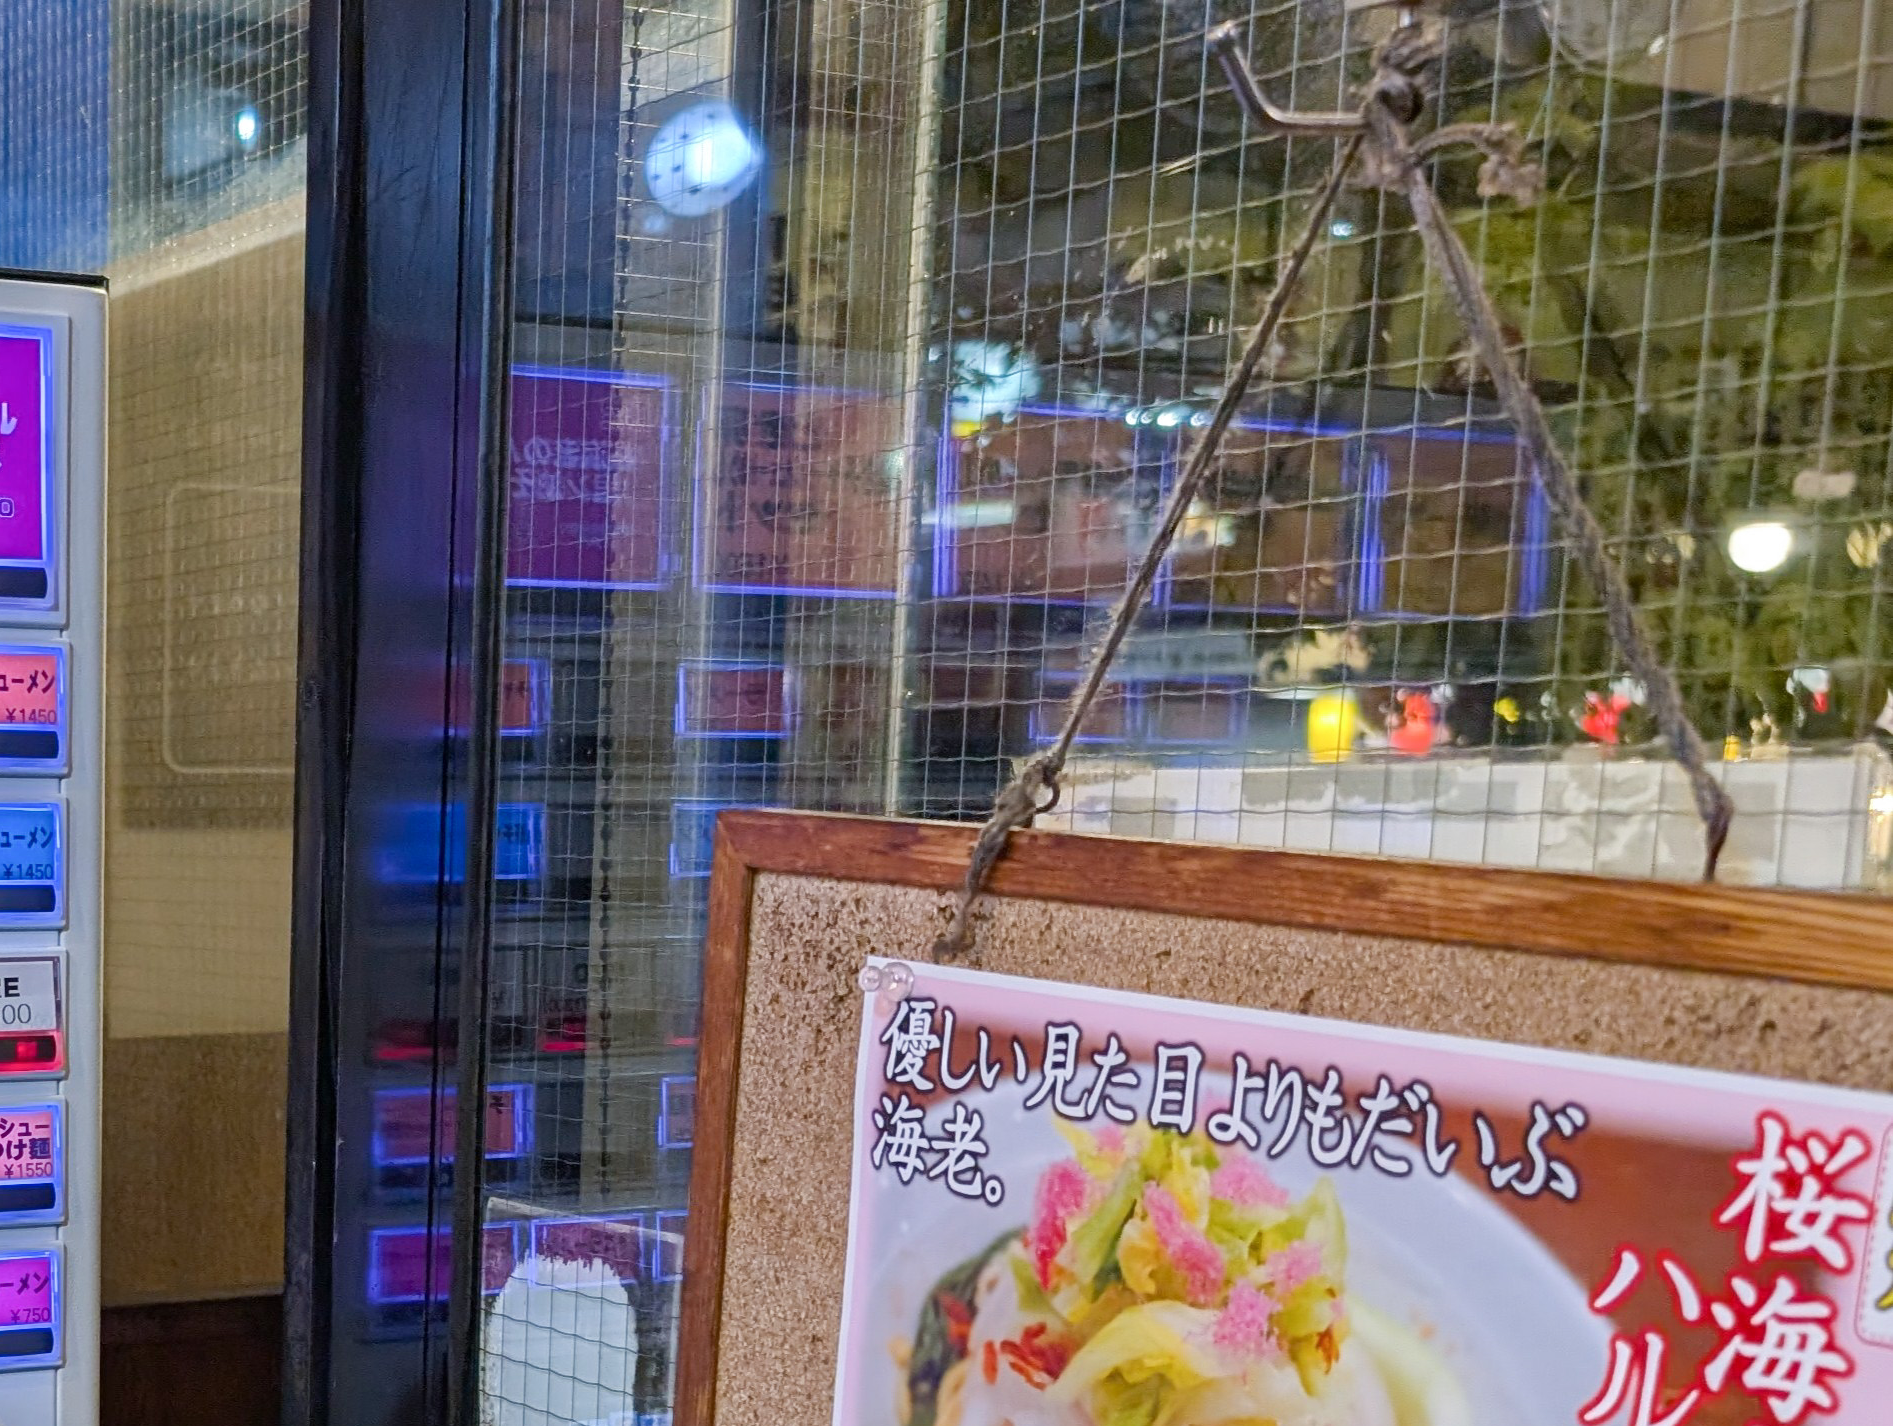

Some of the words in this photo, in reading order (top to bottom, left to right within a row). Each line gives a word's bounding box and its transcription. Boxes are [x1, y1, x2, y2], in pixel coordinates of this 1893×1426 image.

[870, 1095, 1007, 1206] 海老。
[878, 997, 1589, 1201] 優しい見た目よりもだいぶ
[9, 1306, 51, 1325] ¥750
